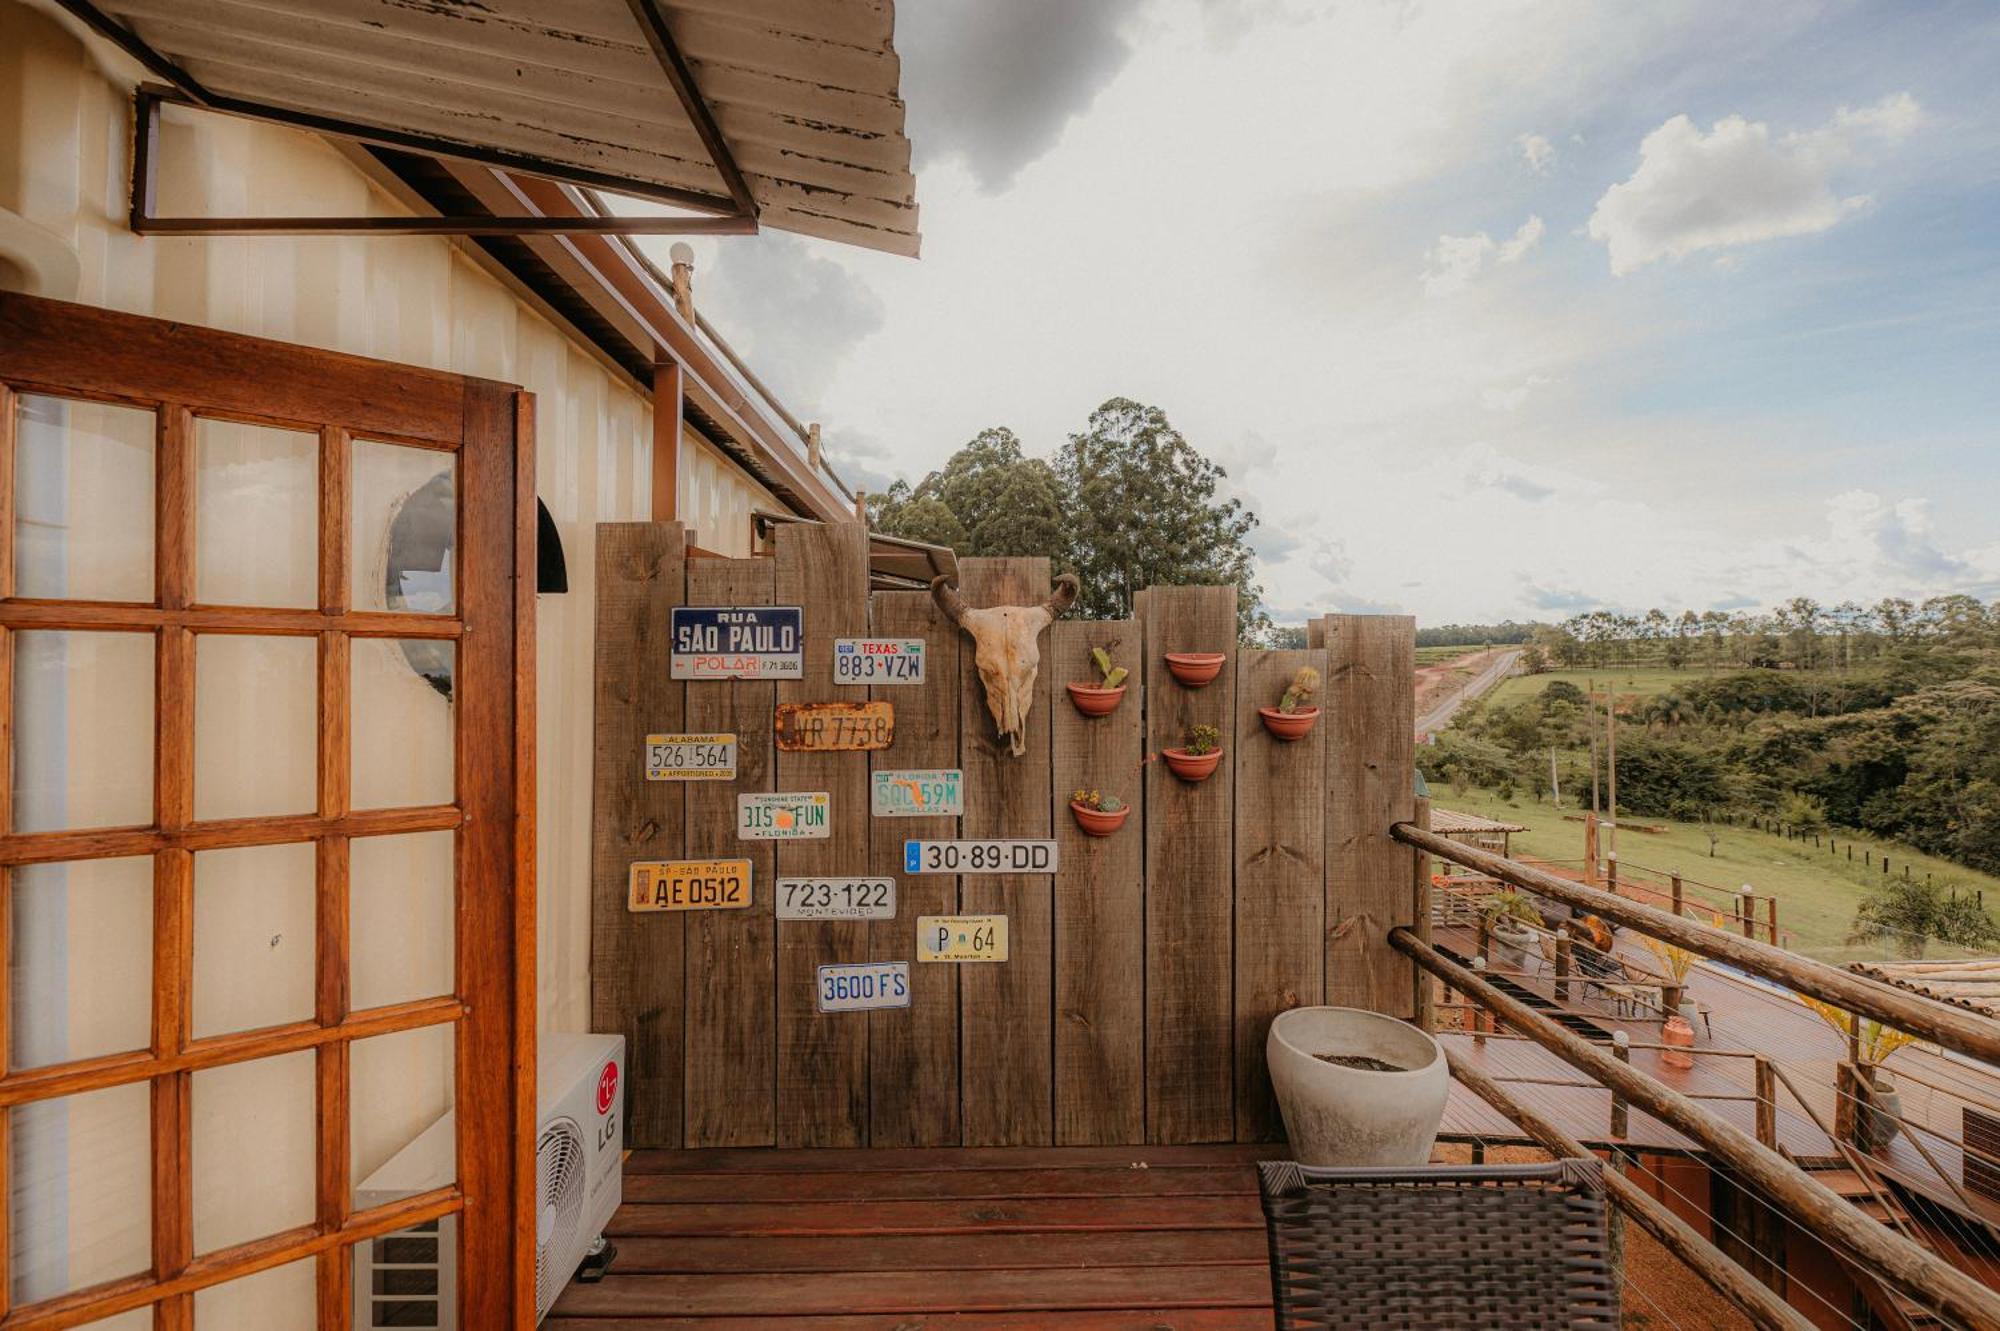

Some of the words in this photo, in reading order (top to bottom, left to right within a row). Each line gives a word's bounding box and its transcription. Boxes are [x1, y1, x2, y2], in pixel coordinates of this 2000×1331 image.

[717, 613, 758, 623] RUA
[729, 626, 794, 652] PAULO
[862, 643, 898, 654] TEXAS
[696, 657, 758, 670] POLAR
[839, 655, 874, 677] 883
[884, 655, 919, 677] VZW
[653, 746, 684, 767] 526
[695, 745, 728, 767] 564
[795, 805, 824, 827] FUN
[655, 879, 683, 905] AE
[689, 877, 740, 903] 0512
[938, 927, 949, 952] P
[973, 926, 994, 951] 64
[824, 975, 874, 1001] 3600
[598, 1113, 615, 1152] LG
